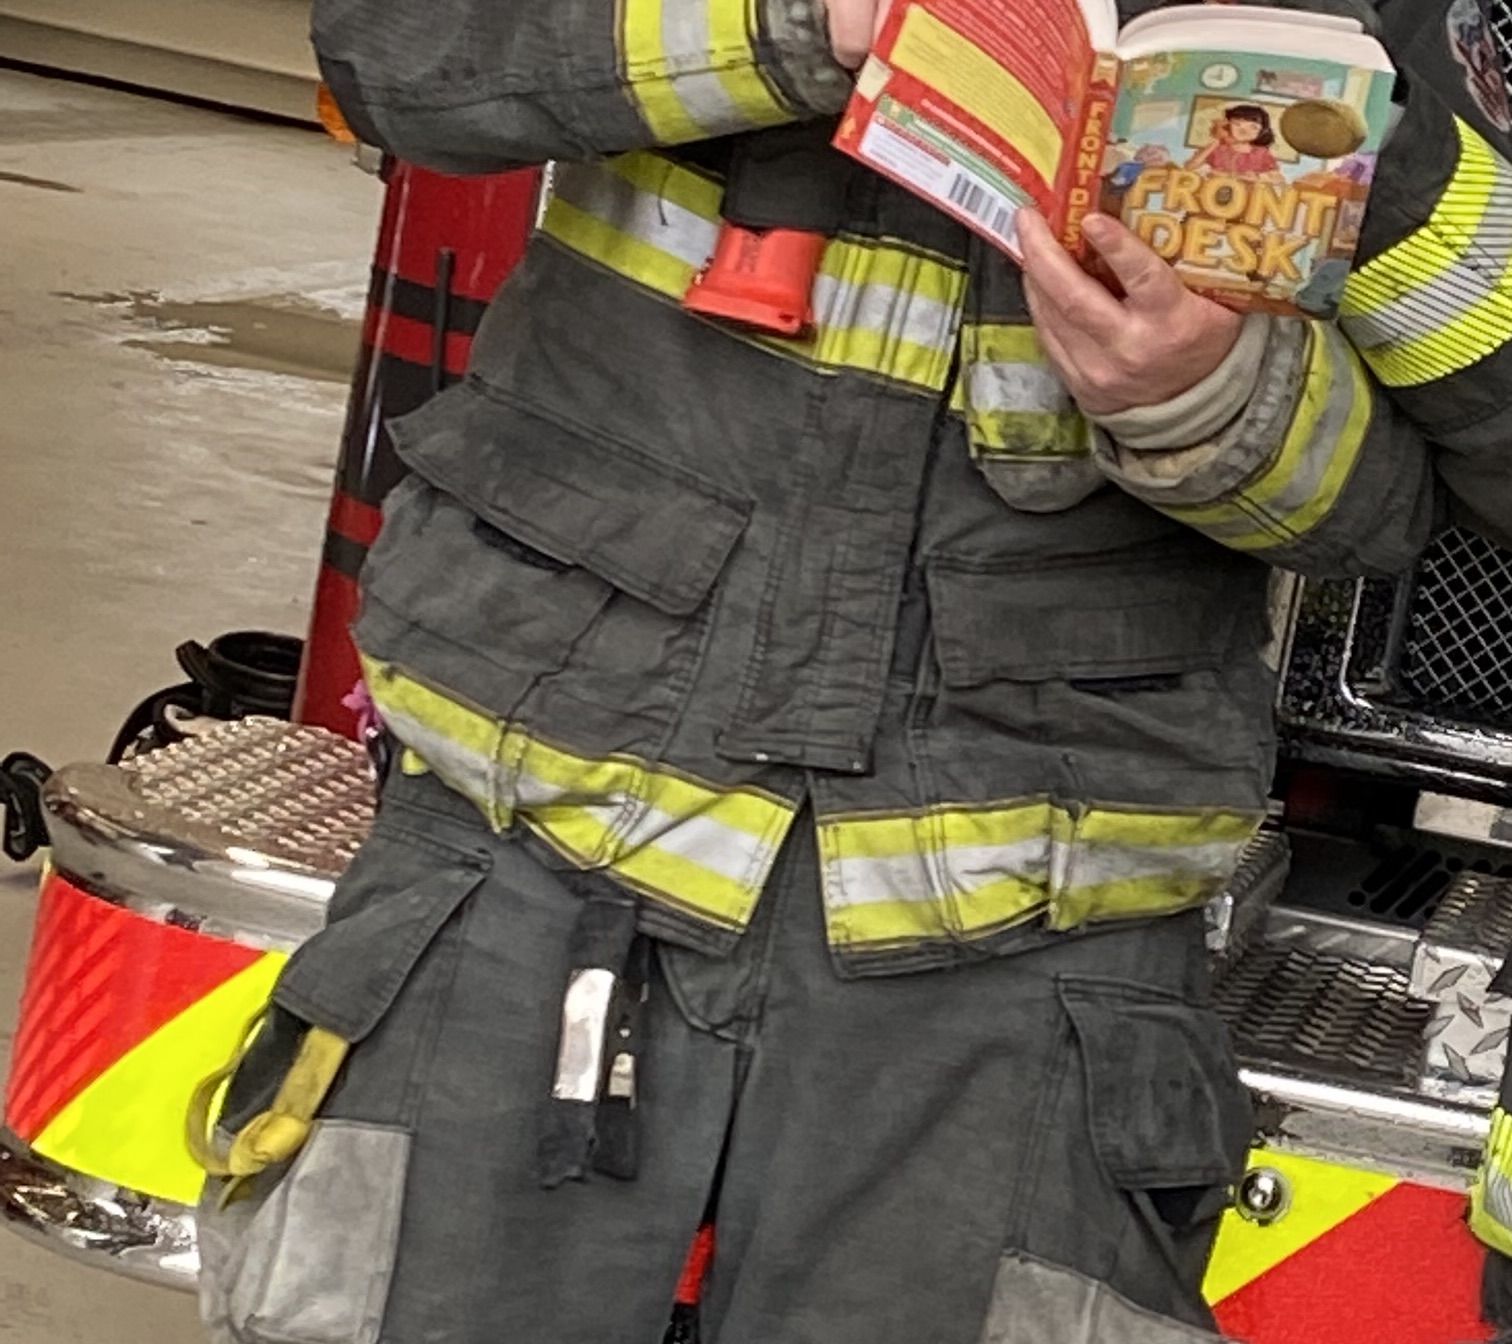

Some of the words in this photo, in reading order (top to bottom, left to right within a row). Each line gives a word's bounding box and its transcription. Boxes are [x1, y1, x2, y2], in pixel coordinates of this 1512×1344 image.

[1075, 100, 1108, 187] FRONT
[1063, 187, 1090, 250] DES
[1126, 168, 1338, 238] FRONT
[1137, 212, 1307, 281] DESK
